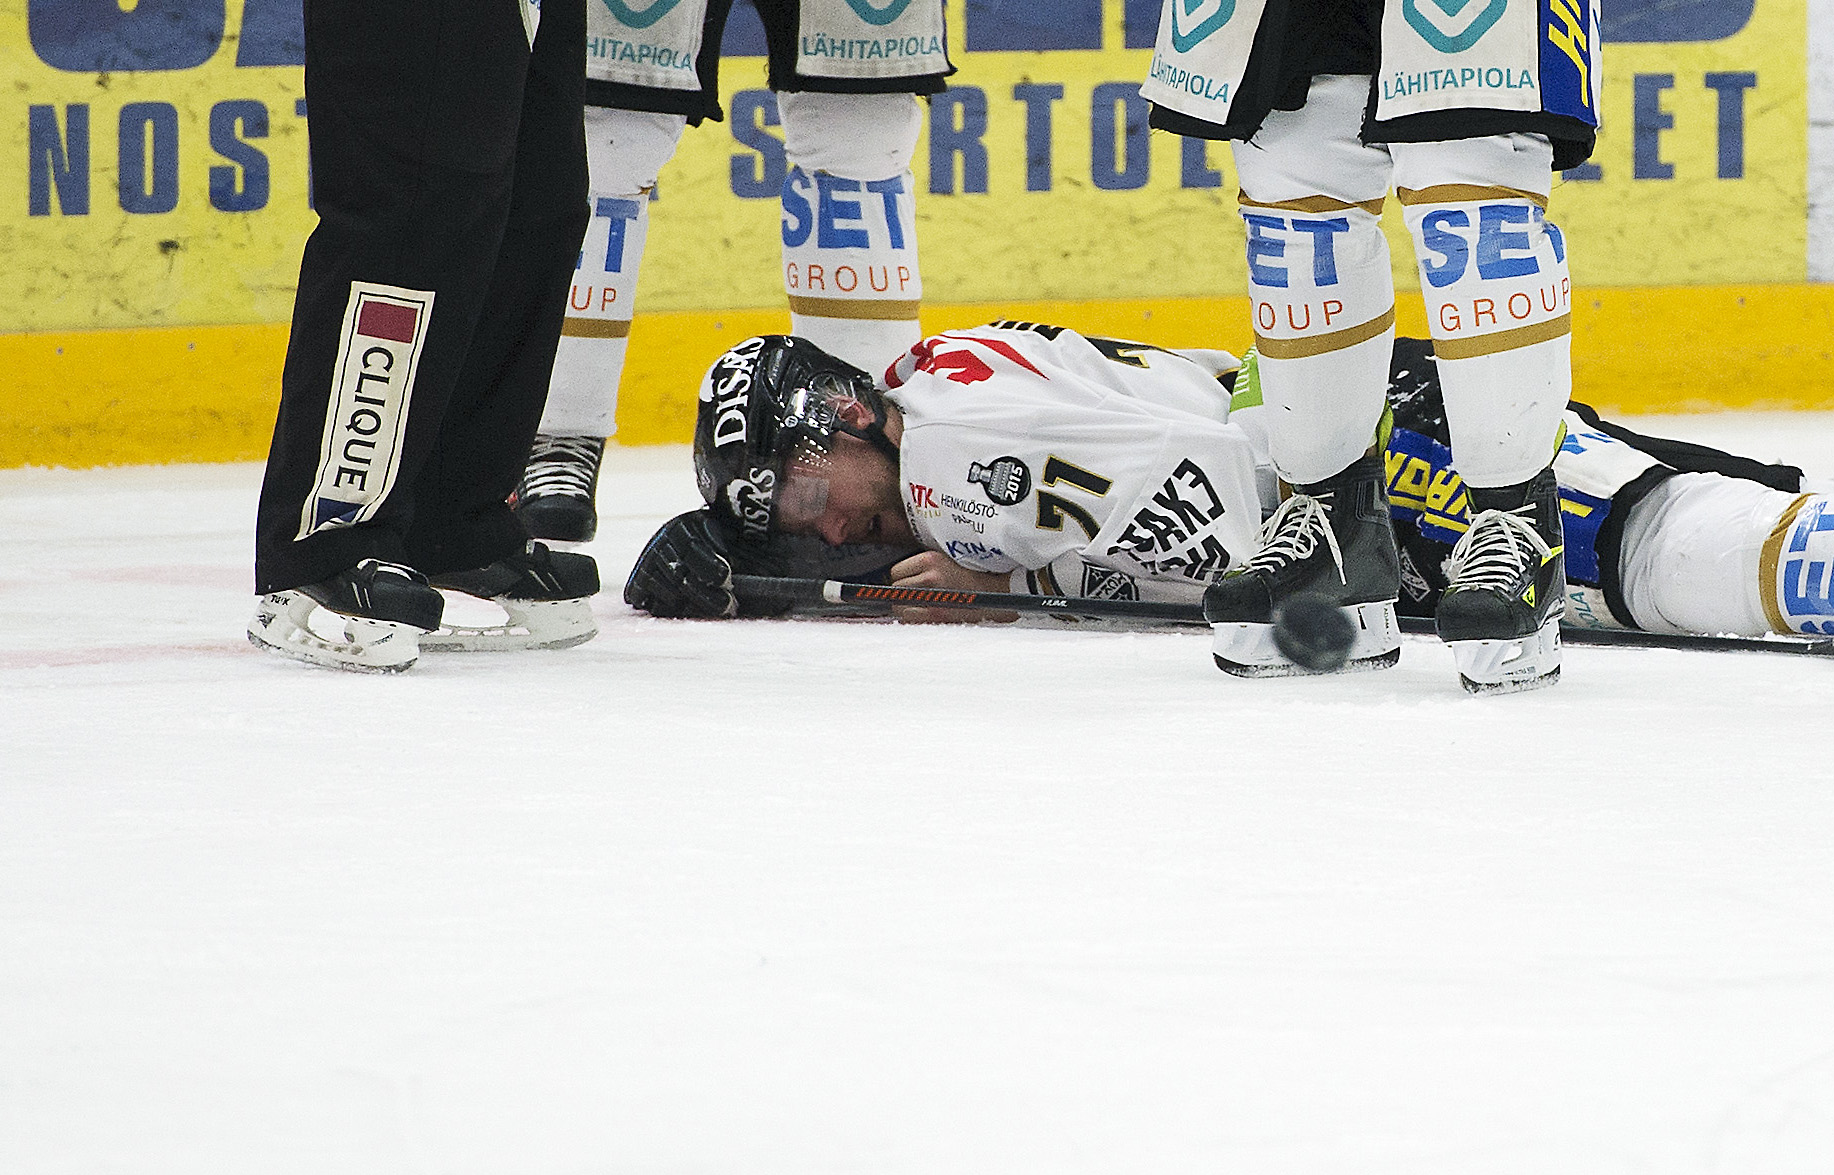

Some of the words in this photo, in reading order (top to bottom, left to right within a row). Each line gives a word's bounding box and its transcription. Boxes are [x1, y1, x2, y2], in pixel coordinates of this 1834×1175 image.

[587, 36, 695, 73] HITAPIOLA
[802, 35, 943, 60] LÄHITAPIOLA
[1150, 57, 1231, 105] LÄHITAPIOLA
[1383, 65, 1536, 102] LÄHITAPIOLA
[781, 170, 907, 251] SET
[1242, 213, 1351, 289] ET
[786, 261, 912, 293] GROUP
[1253, 298, 1344, 332] OUP
[1439, 276, 1572, 333] GROUP
[332, 345, 395, 494] CLIQUE
[1003, 465, 1024, 503] 2015
